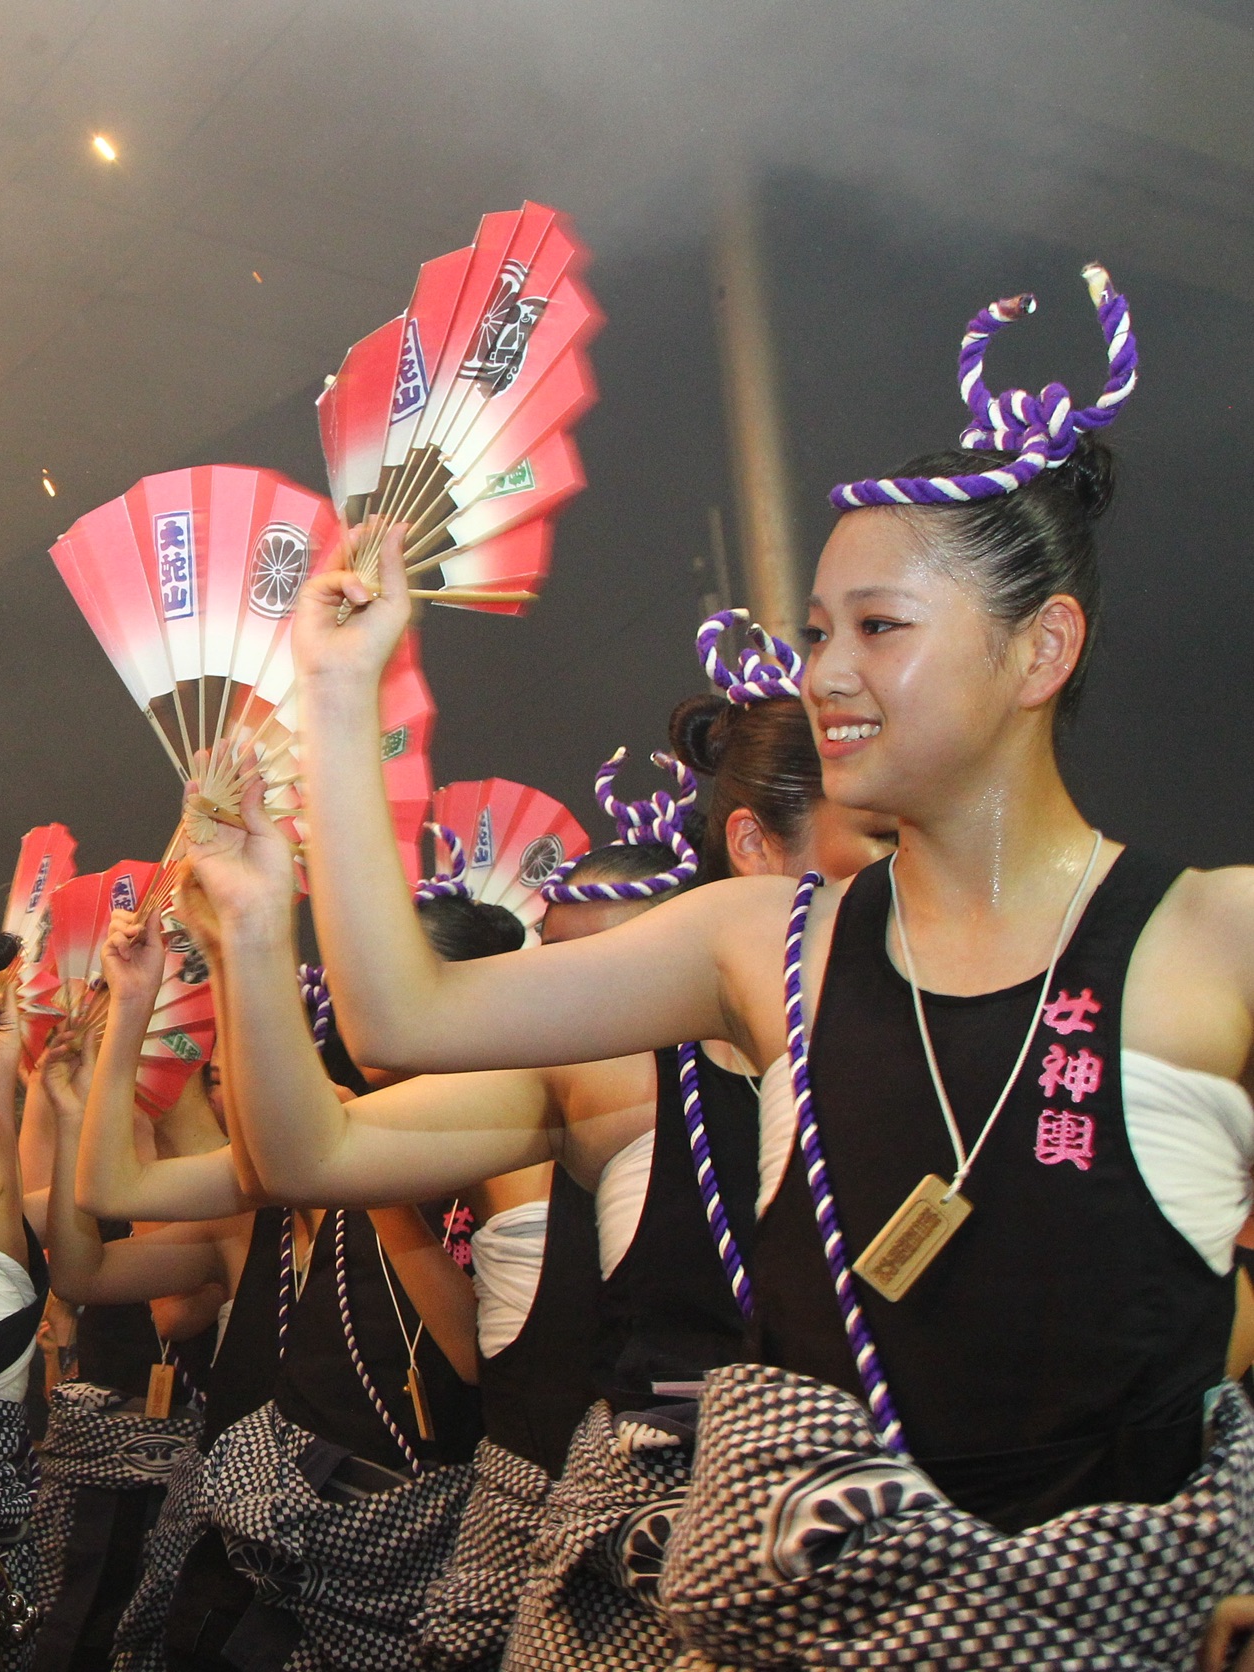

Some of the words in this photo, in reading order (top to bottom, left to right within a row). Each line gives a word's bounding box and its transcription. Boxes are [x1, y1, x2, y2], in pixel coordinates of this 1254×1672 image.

[393, 336, 419, 415] 蛇山
[159, 520, 187, 612] 大蛇山
[112, 881, 133, 912] 大蛇
[442, 1206, 475, 1270] 女神
